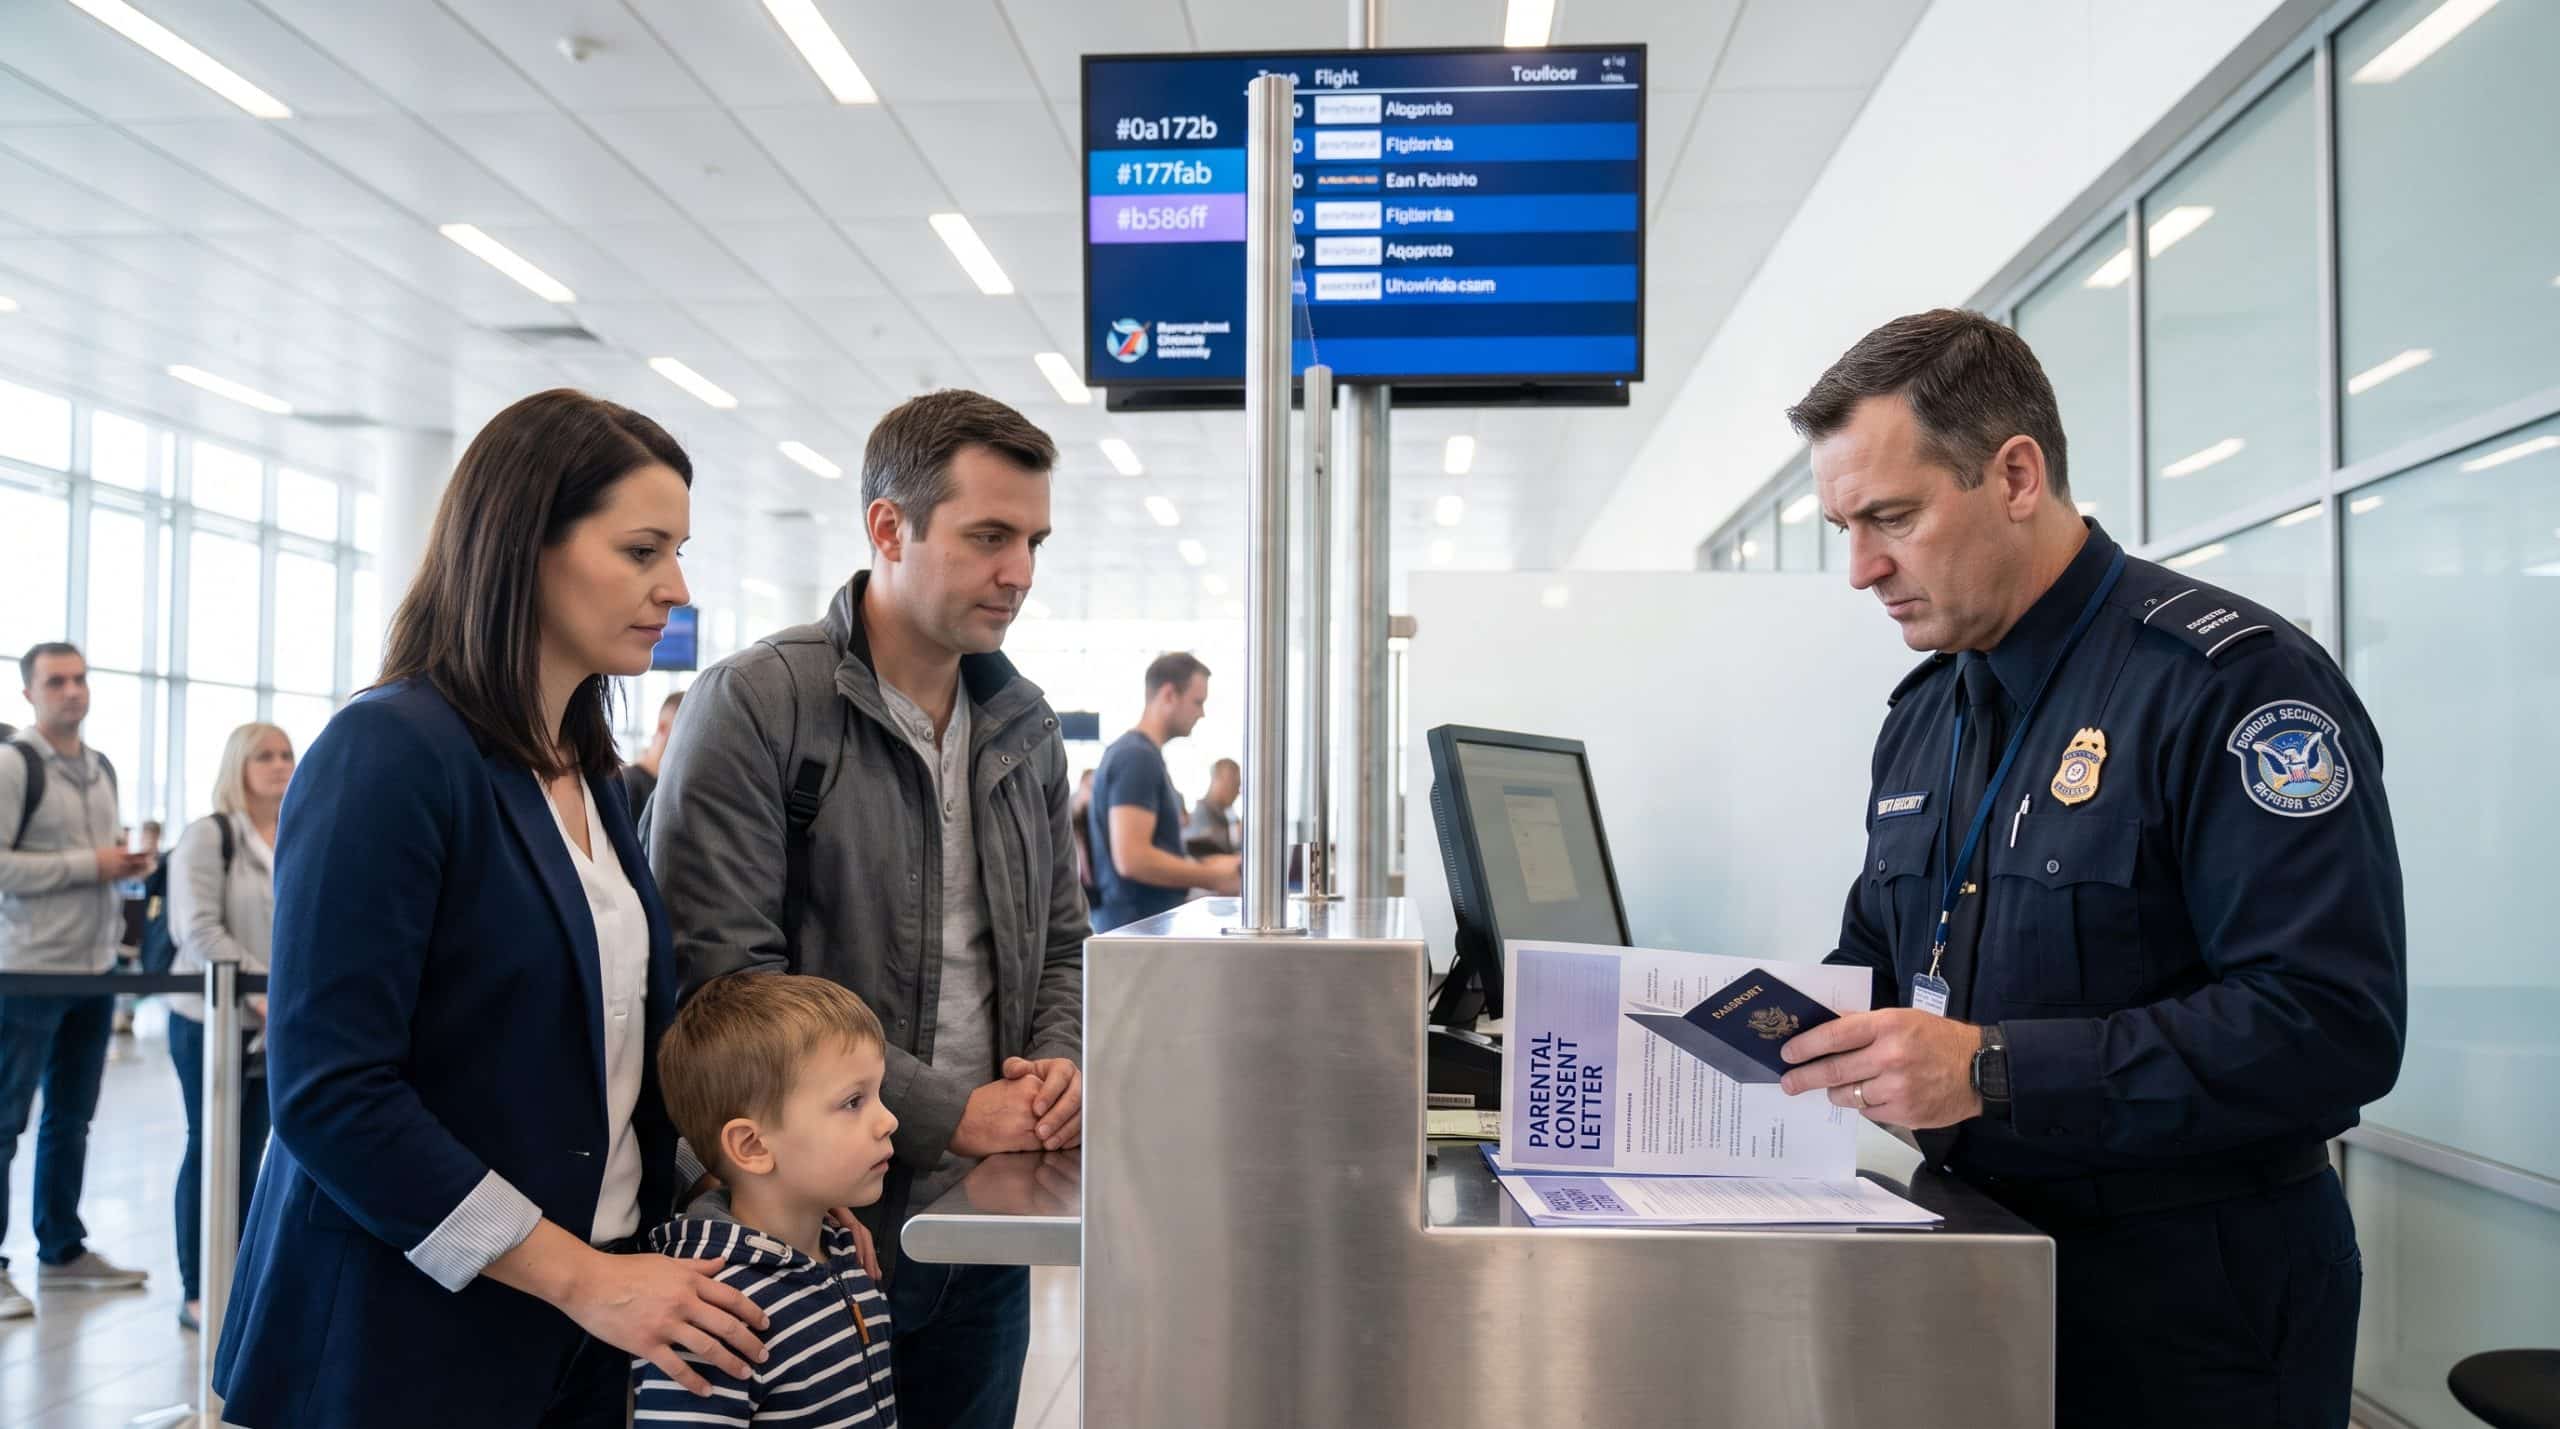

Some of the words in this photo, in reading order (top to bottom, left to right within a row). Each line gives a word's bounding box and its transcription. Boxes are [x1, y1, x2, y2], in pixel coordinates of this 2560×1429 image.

[1314, 69, 1359, 88] Flight
[1115, 114, 1218, 140] #0a172b
[1117, 159, 1213, 185] #177fab
[1117, 204, 1209, 230] #b586ff
[1528, 1031, 1551, 1148] PARENTAL
[1554, 1037, 1577, 1149] CONSENT
[1580, 1065, 1603, 1150] LETTER
